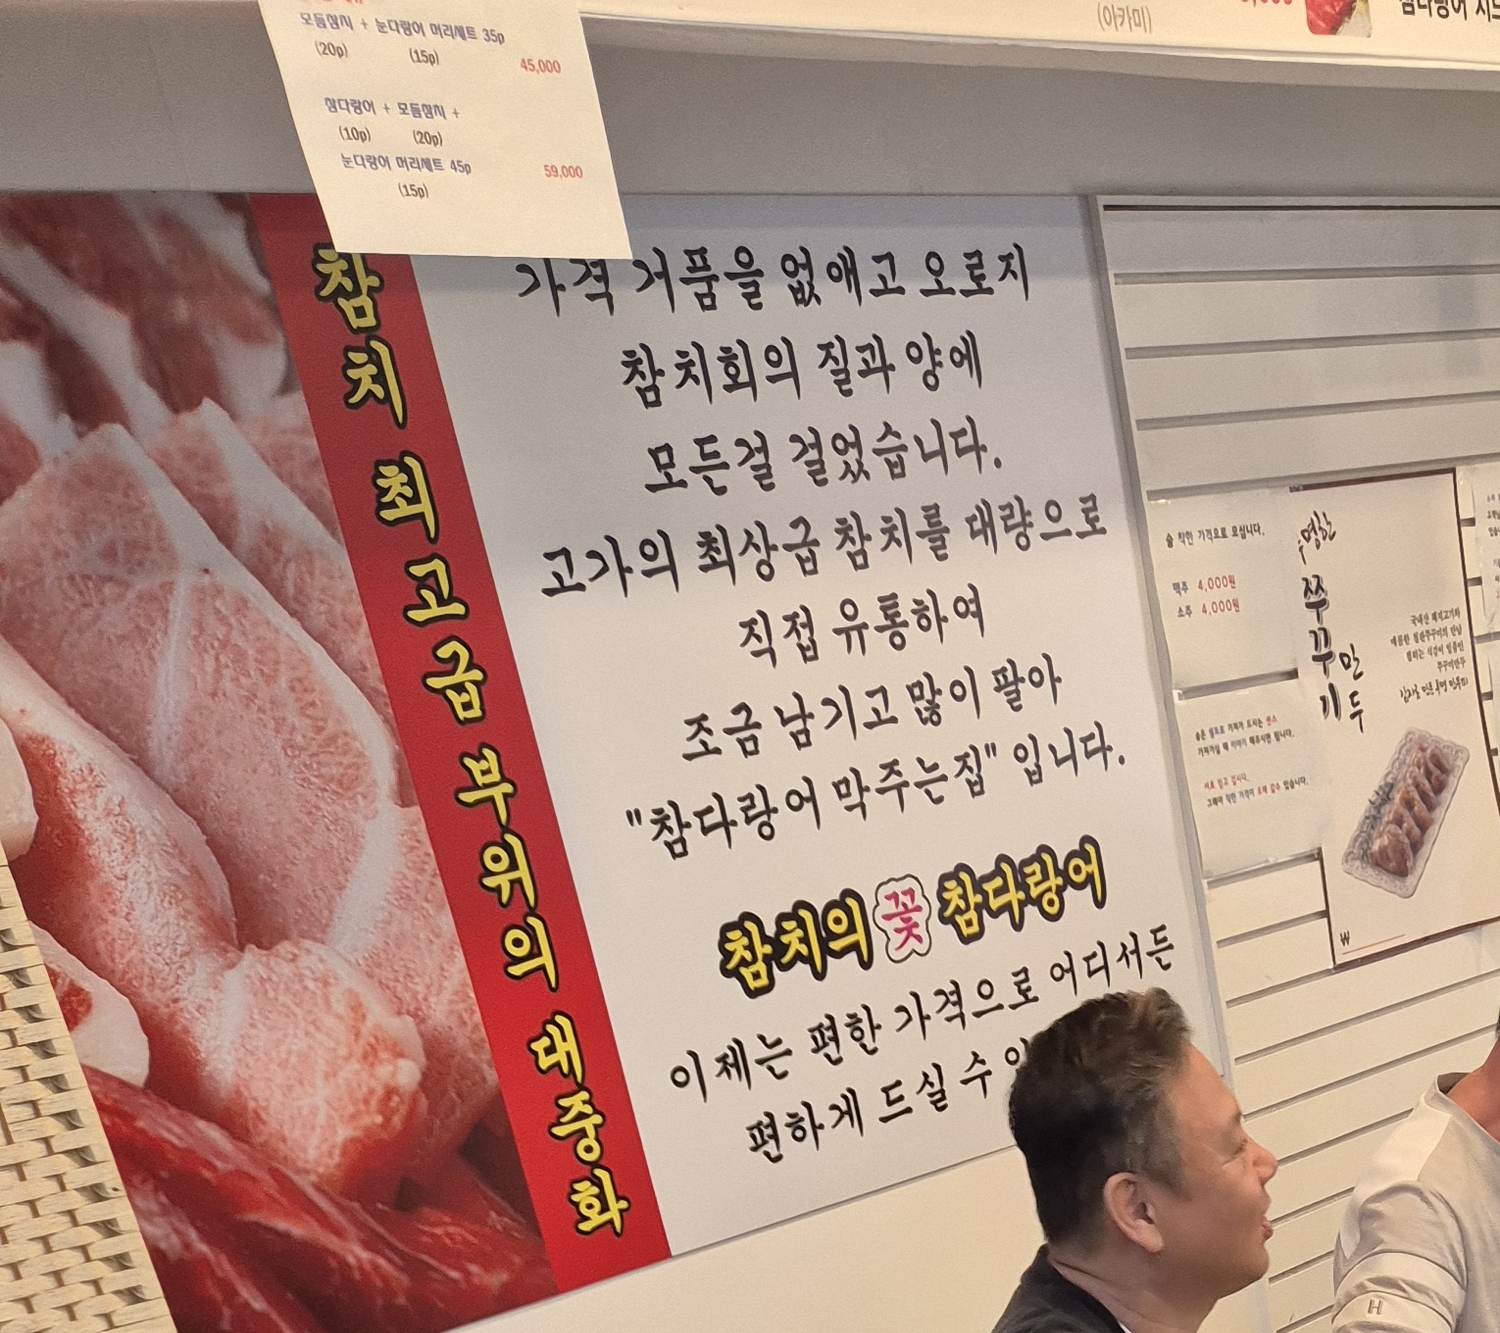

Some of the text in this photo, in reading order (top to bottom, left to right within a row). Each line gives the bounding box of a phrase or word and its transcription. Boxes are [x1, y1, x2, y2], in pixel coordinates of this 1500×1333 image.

[315, 41, 439, 67] (20p) (15p)
[375, 18, 426, 37] 눈다랑어
[429, 23, 478, 42] 머리세트
[483, 28, 505, 45] 35p
[520, 58, 561, 75] 45,000
[324, 97, 376, 116] 참다랑어
[339, 125, 443, 148] (10p) (20p)
[341, 153, 471, 176] 눈다랑어 머리세트 45p
[544, 164, 583, 181] 59,000
[398, 182, 429, 200] (15p)
[517, 241, 1031, 317] 가격 거품을 없애고 오로지
[620, 329, 985, 410] 참치회의 질과 양에
[643, 414, 1003, 494] 모든걸 걸었습니다.
[541, 491, 1109, 599] 고가의 최상급 참치를 대량으로
[1198, 526, 1229, 544] 가격으로
[1172, 574, 1237, 597] 맥주 4,000원
[1177, 597, 1241, 619] 소주 4,000원
[738, 582, 988, 668] 직접 유통하여
[681, 652, 1064, 763] 조금 남기고 많이 팔아
[312, 243, 631, 1237] 참치 최고급 부위의 대중화
[624, 719, 1128, 862] "참다랑어 막주는집" 입니다.
[717, 834, 1108, 999] 참치의 꽃 참다랑어
[669, 922, 1177, 1104] 이제는 편한 가격으로 어디서든
[746, 1087, 865, 1166] 편하게
[877, 1061, 951, 1126] 드실
[957, 1050, 995, 1101] 수
